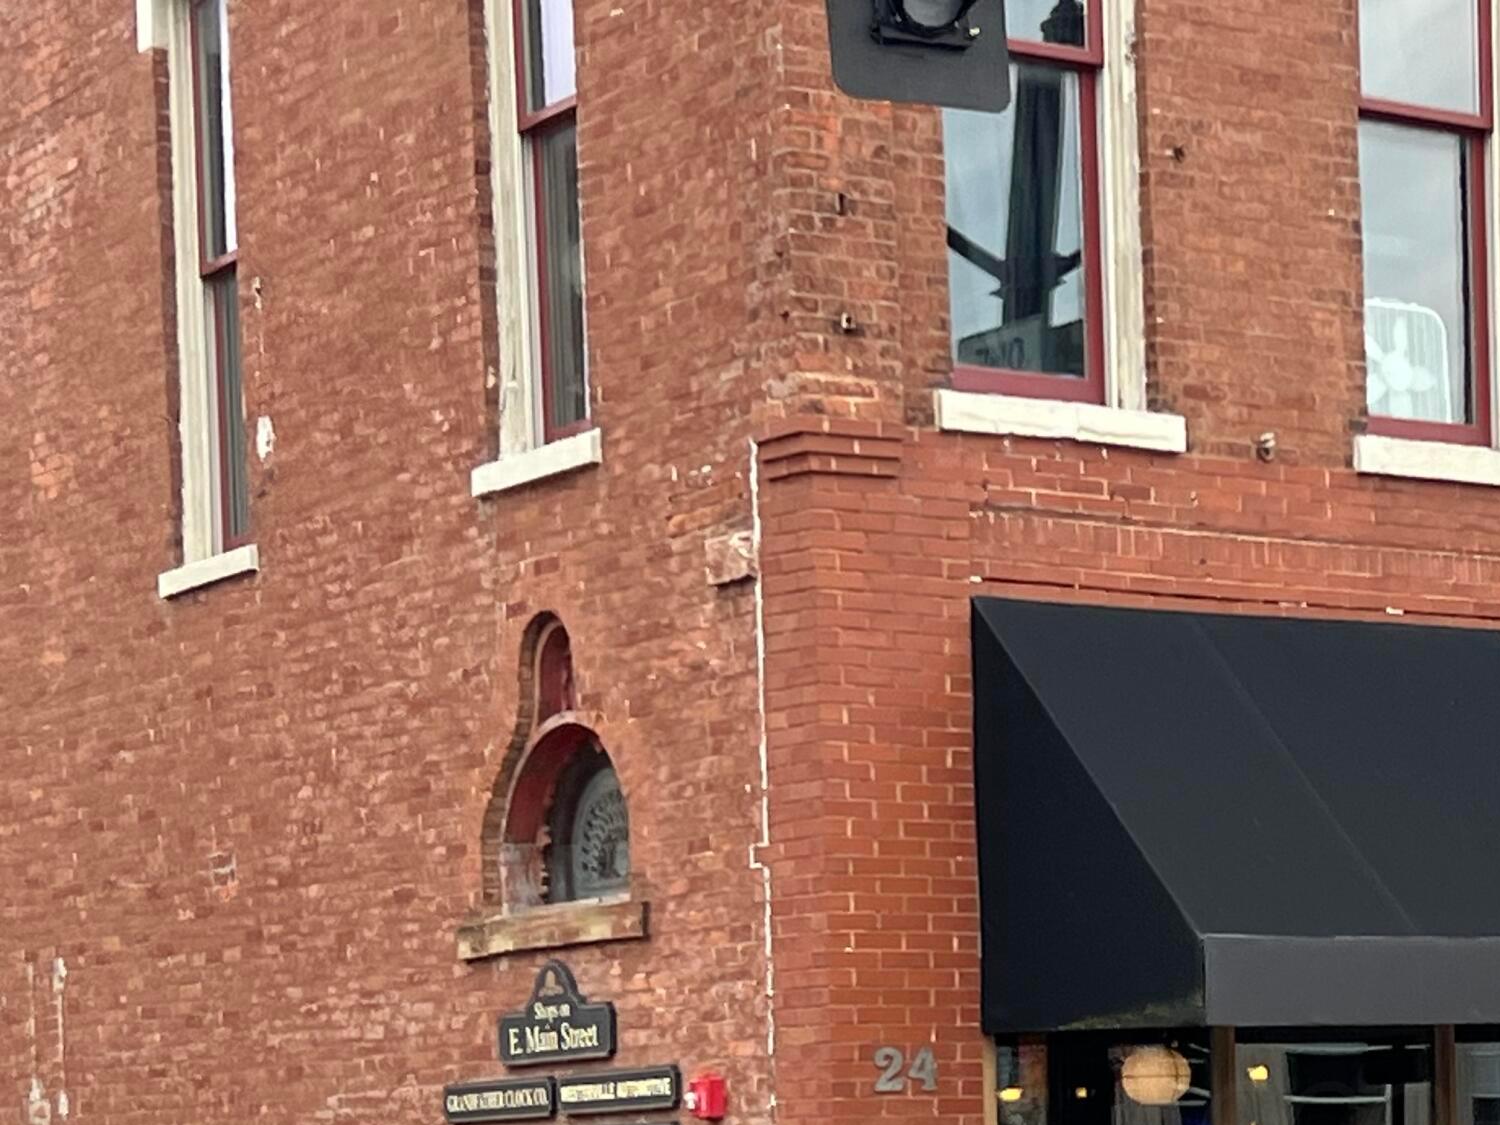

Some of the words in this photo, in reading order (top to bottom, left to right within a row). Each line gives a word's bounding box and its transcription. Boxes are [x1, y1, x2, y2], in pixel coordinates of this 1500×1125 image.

[533, 1001, 558, 1023] Shops
[525, 1026, 559, 1053] Main
[560, 1022, 599, 1050] Street
[873, 1046, 938, 1093] 24
